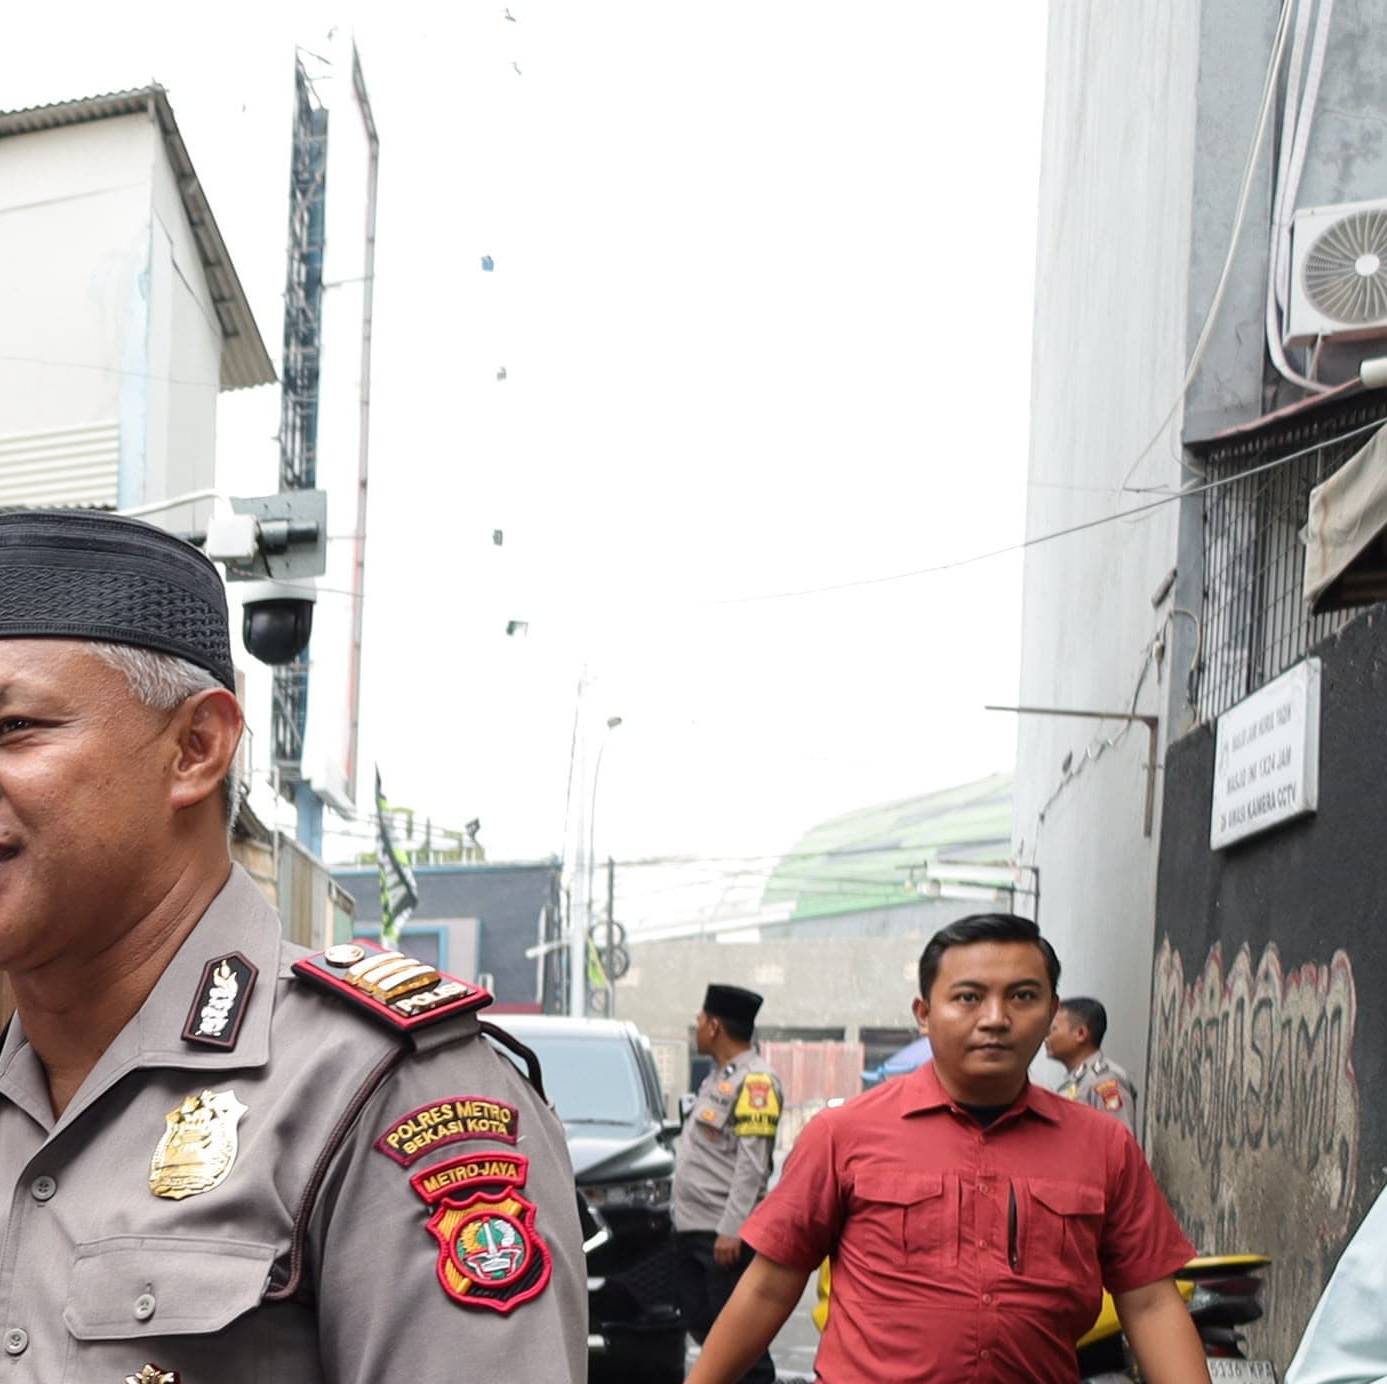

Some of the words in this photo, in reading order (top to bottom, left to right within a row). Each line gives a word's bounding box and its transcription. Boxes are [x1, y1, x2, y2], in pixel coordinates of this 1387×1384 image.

[386, 1103, 454, 1149] POLRES
[455, 1101, 512, 1123] METRO
[402, 1119, 465, 1154] BEKASI
[466, 1118, 509, 1135] KOTA
